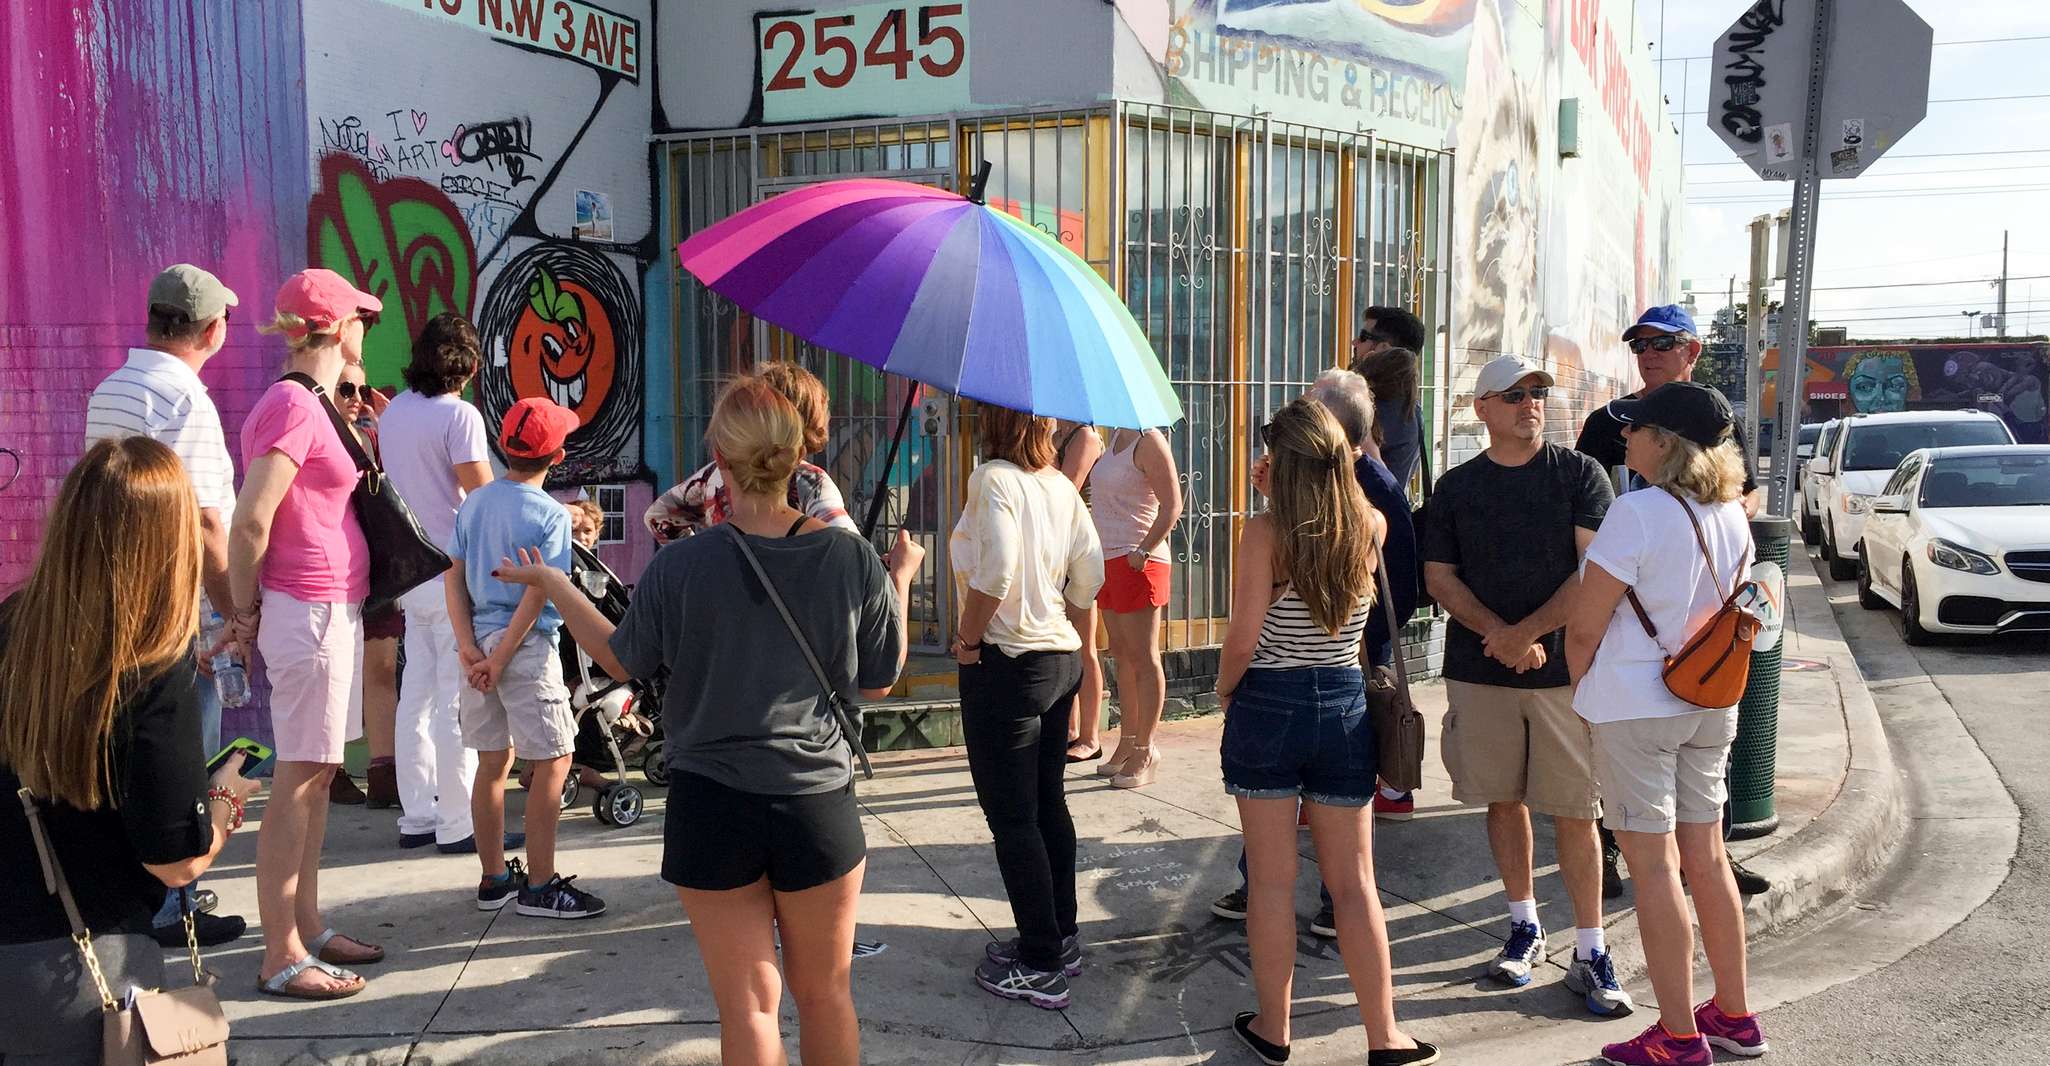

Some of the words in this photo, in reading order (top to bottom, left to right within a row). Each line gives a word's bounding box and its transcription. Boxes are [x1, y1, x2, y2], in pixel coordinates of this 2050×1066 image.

[477, 0, 545, 42] N.W
[554, 1, 577, 52] 3
[581, 12, 635, 73] AVE
[763, 3, 965, 92] 2545
[1341, 63, 1361, 109] &
[1602, 16, 1631, 158] SHOES
[1633, 98, 1652, 197] CORP
[399, 140, 438, 172] ART
[1809, 392, 1847, 400] SHOES
